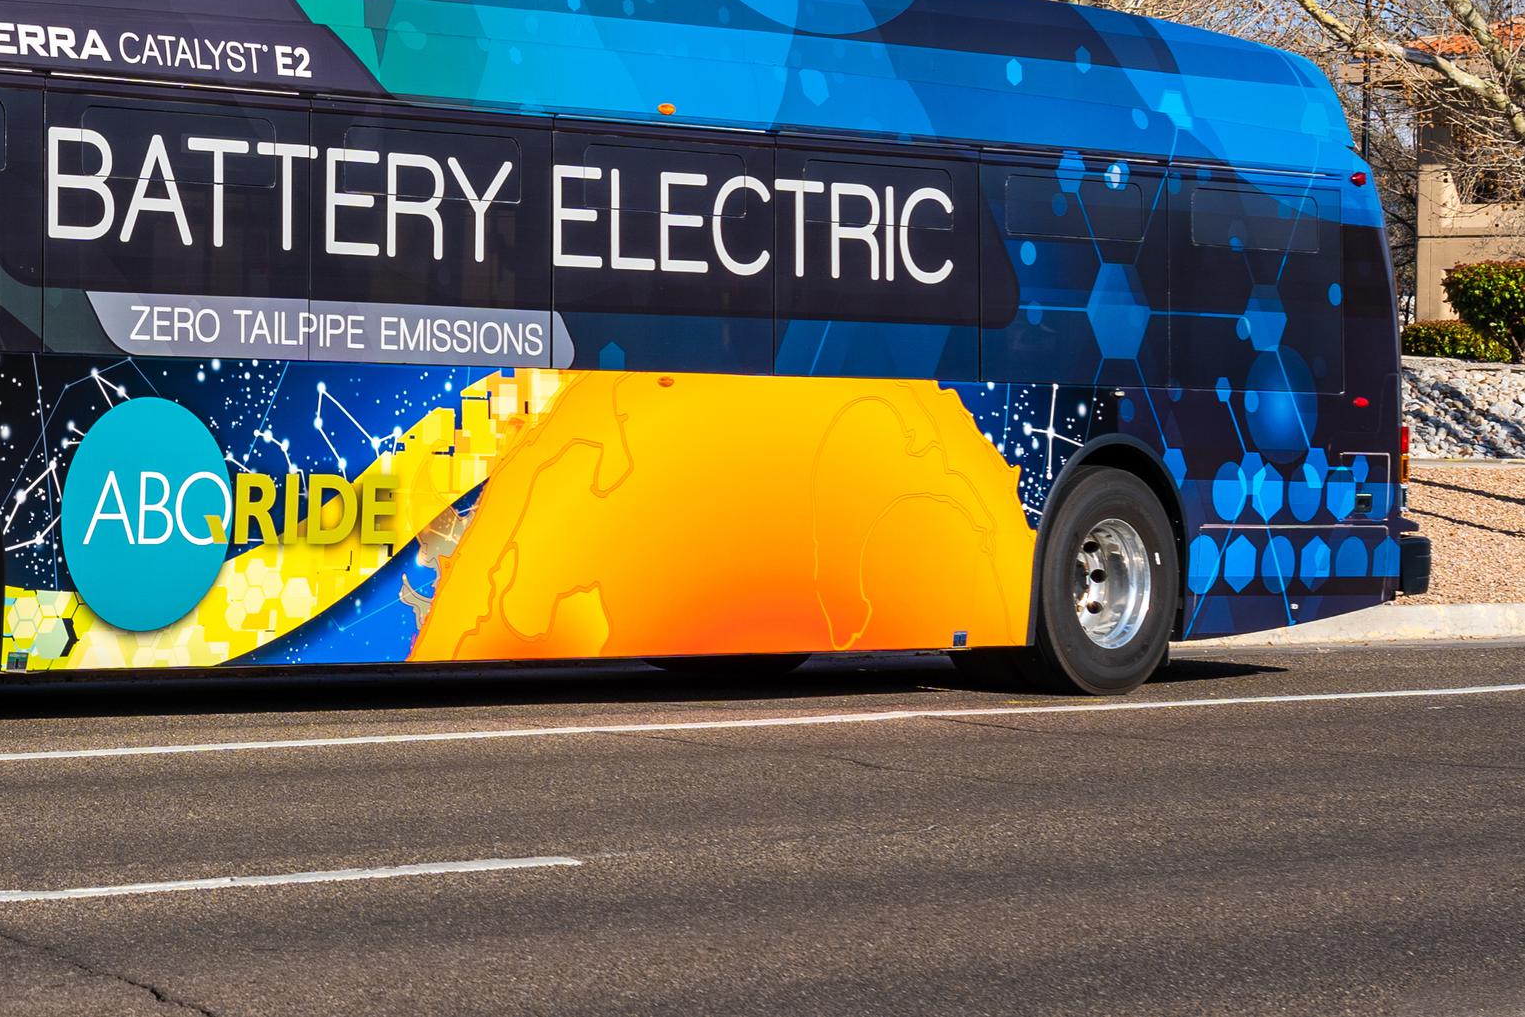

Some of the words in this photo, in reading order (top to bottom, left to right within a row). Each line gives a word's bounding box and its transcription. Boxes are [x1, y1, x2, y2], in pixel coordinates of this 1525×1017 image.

[274, 45, 313, 78] E2
[47, 125, 514, 263] BATTERY
[552, 164, 955, 285] ELECTRIC
[128, 304, 221, 345] ZERO
[233, 309, 365, 352] TAILPIPE
[379, 314, 545, 357] EMISSIONS
